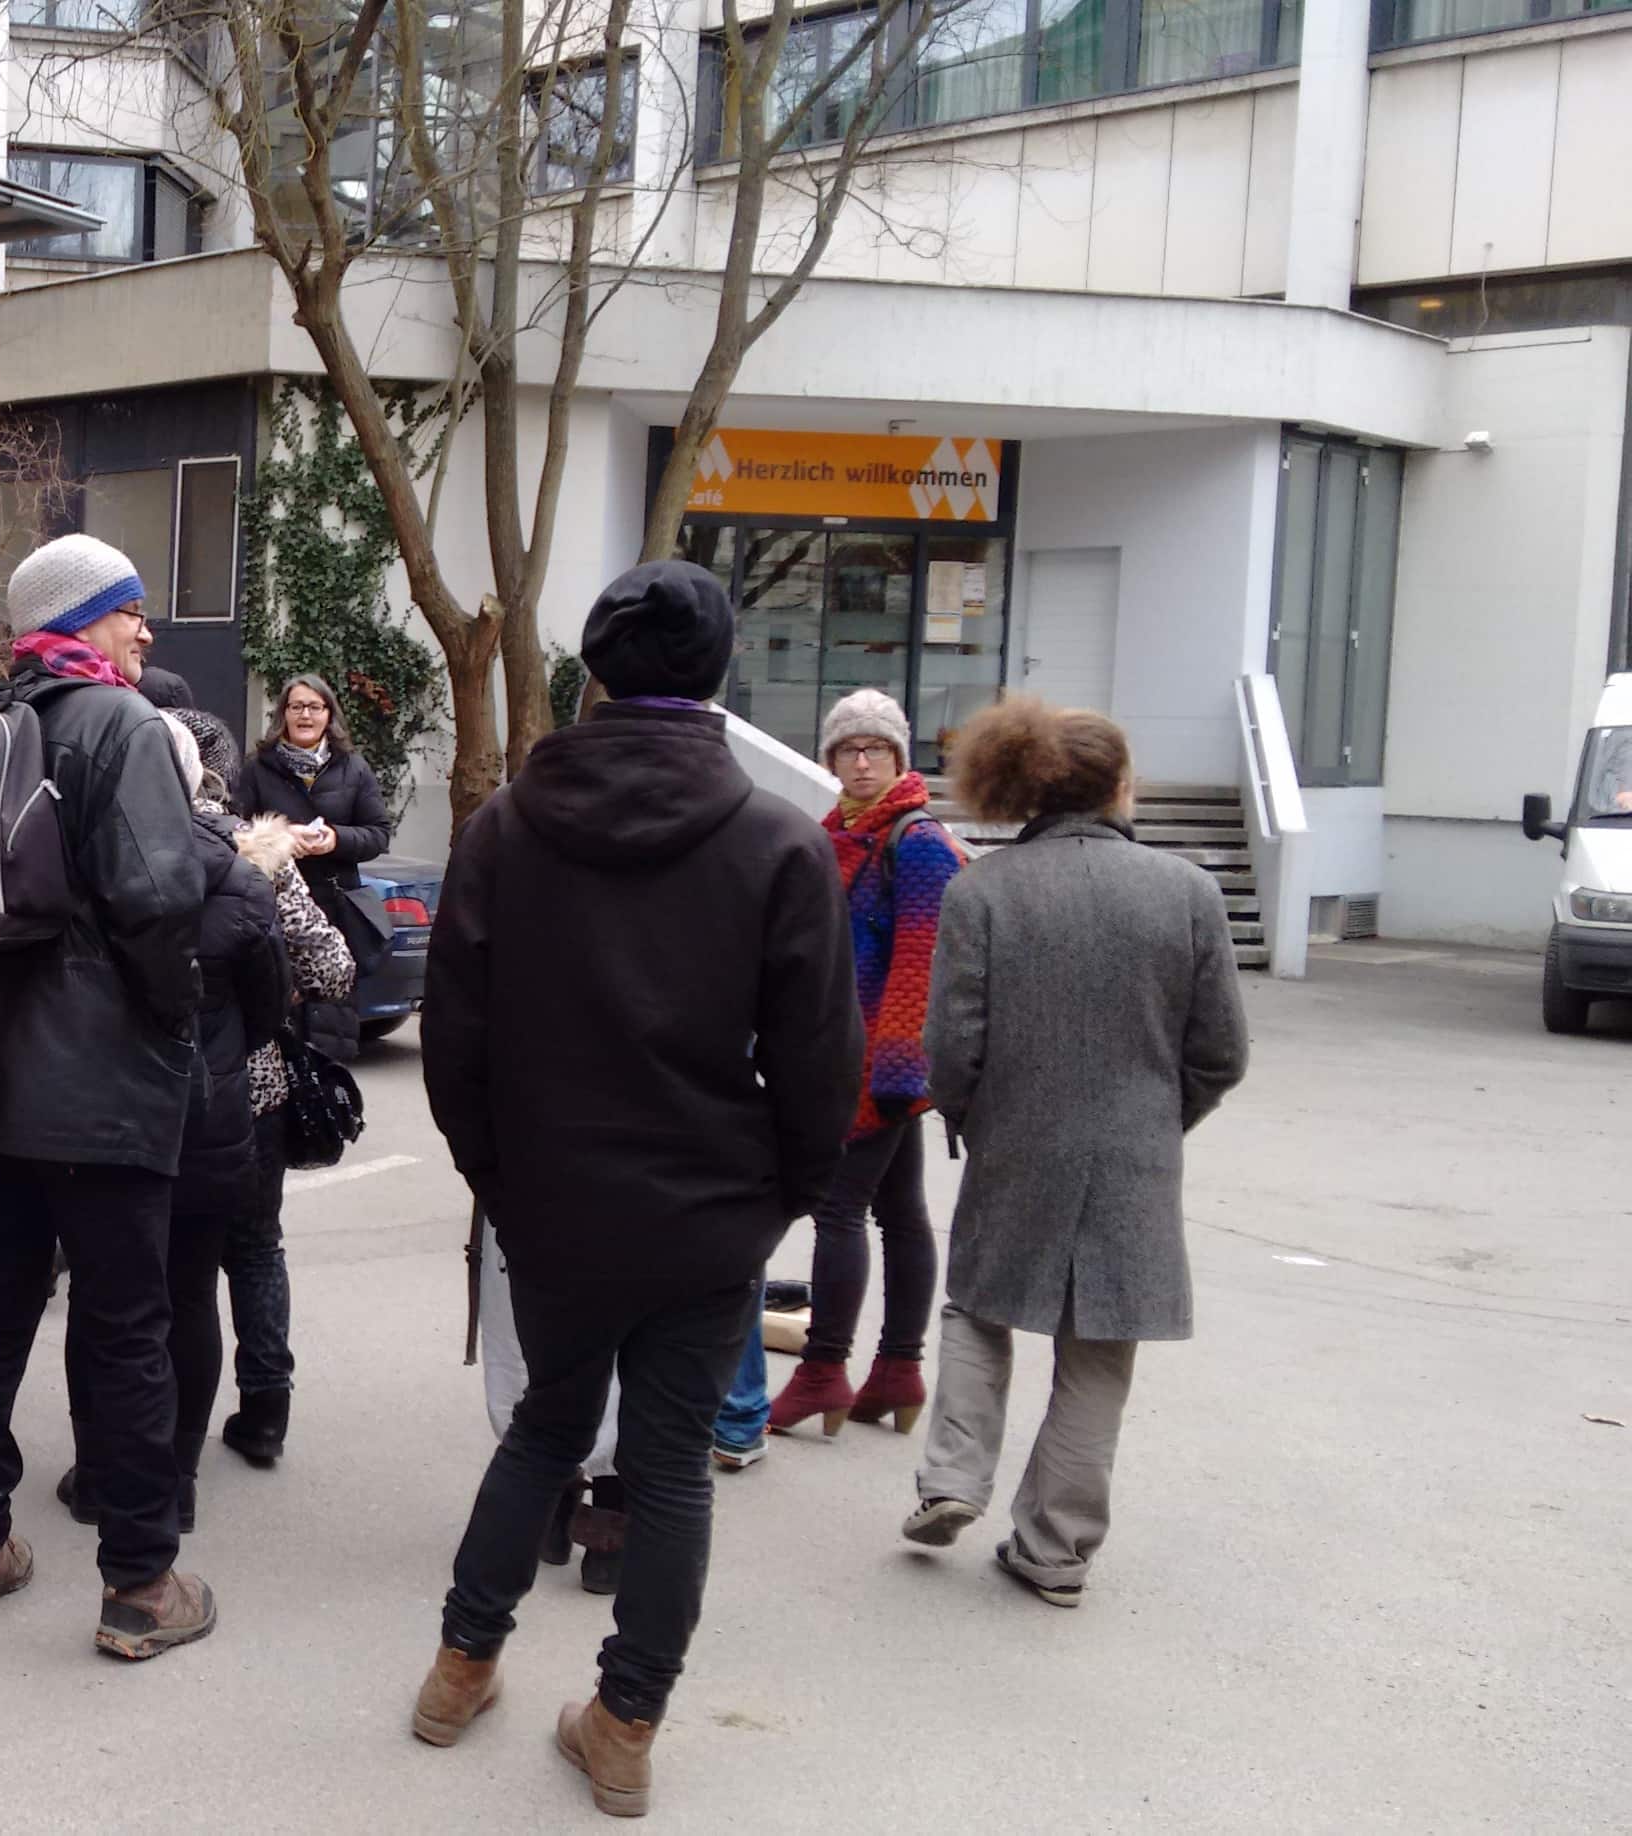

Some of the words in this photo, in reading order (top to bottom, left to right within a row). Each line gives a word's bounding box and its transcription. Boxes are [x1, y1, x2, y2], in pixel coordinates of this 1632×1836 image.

[736, 458, 835, 482] Herzlich
[845, 462, 988, 487] willkommen
[687, 487, 724, 506] afé
